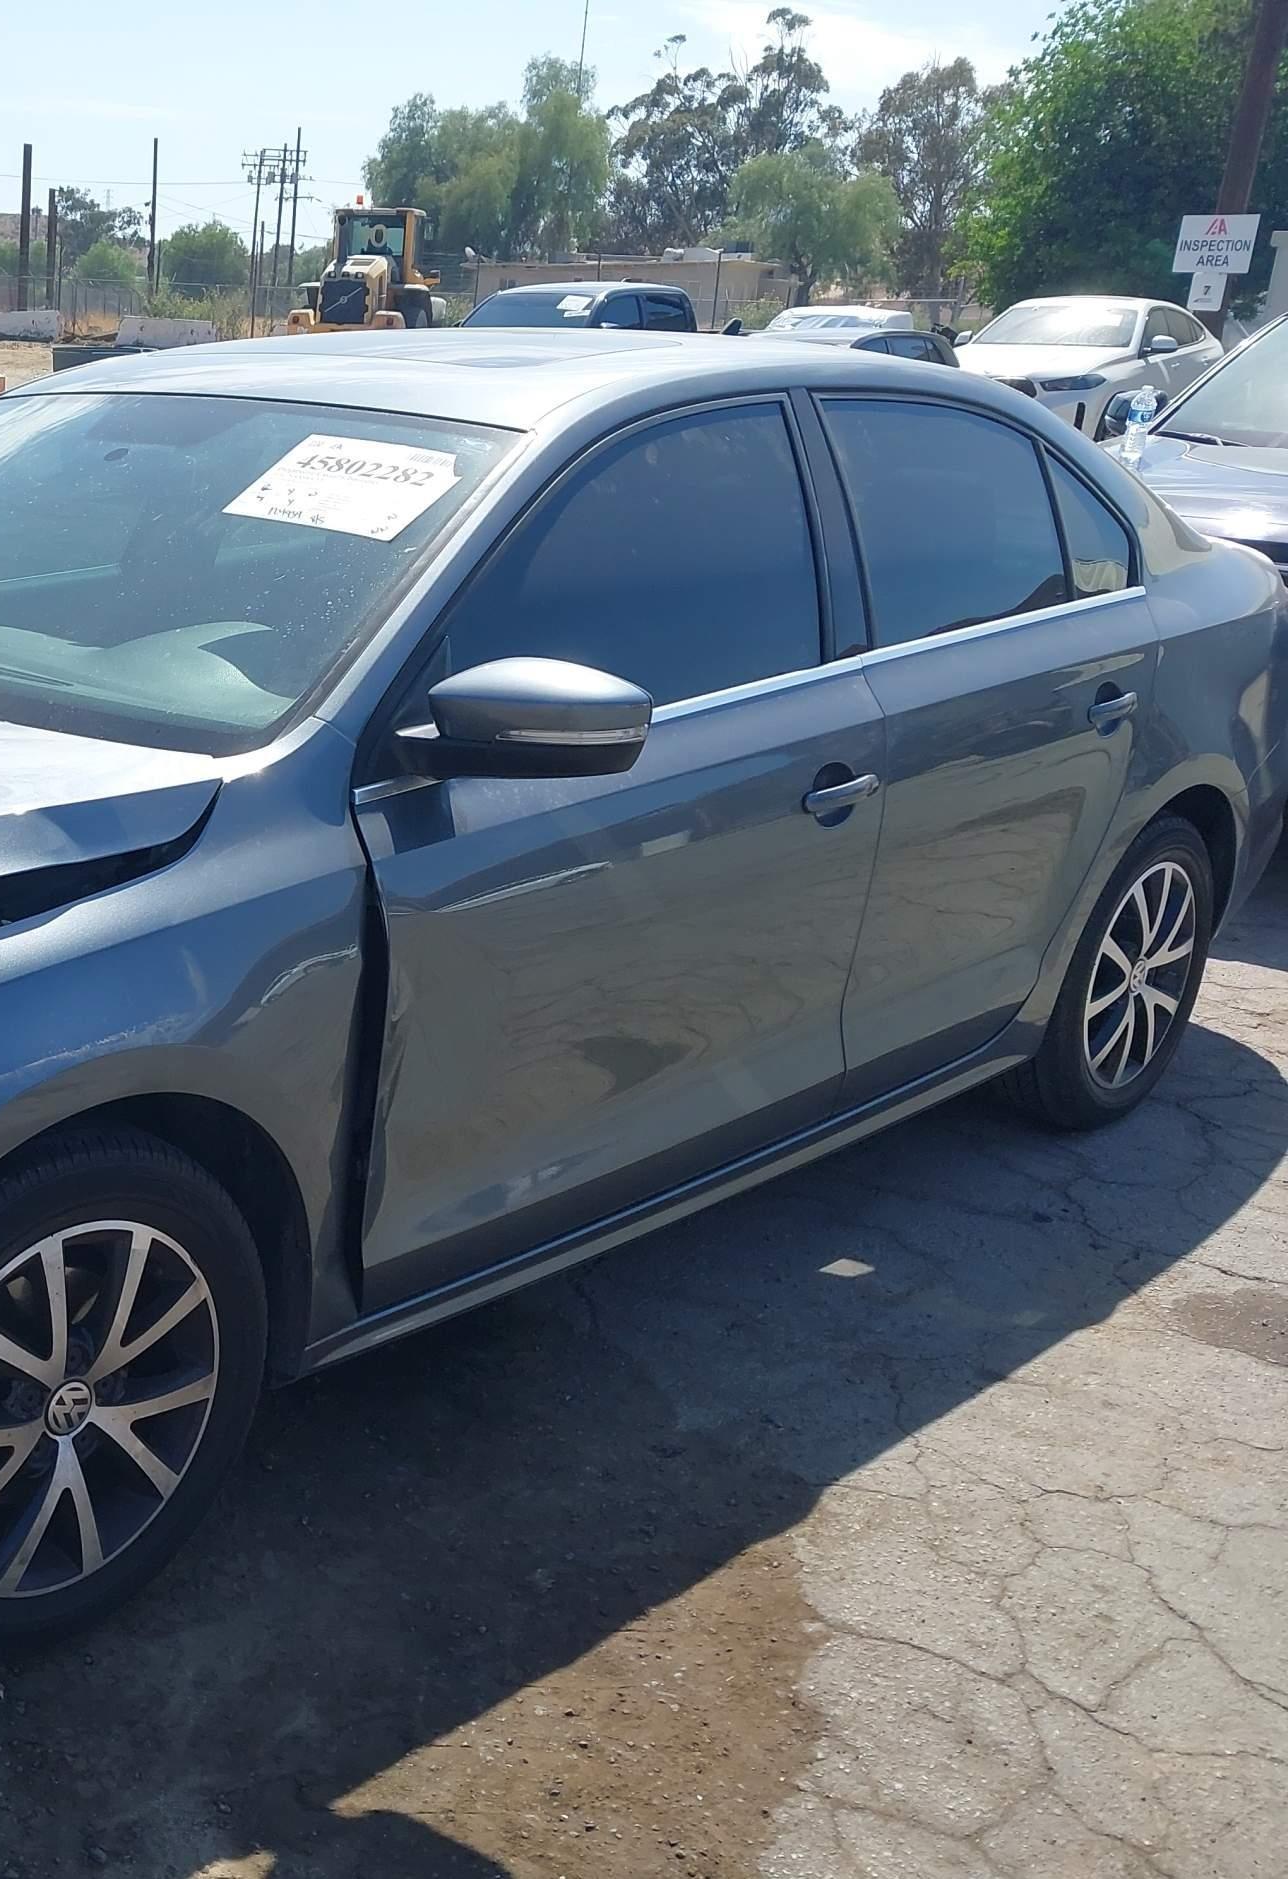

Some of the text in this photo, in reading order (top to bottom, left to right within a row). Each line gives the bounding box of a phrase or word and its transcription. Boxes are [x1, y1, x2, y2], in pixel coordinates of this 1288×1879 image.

[1179, 240, 1251, 252] INSPECTION
[1196, 255, 1229, 267] AREA
[296, 453, 435, 487] 45802282
